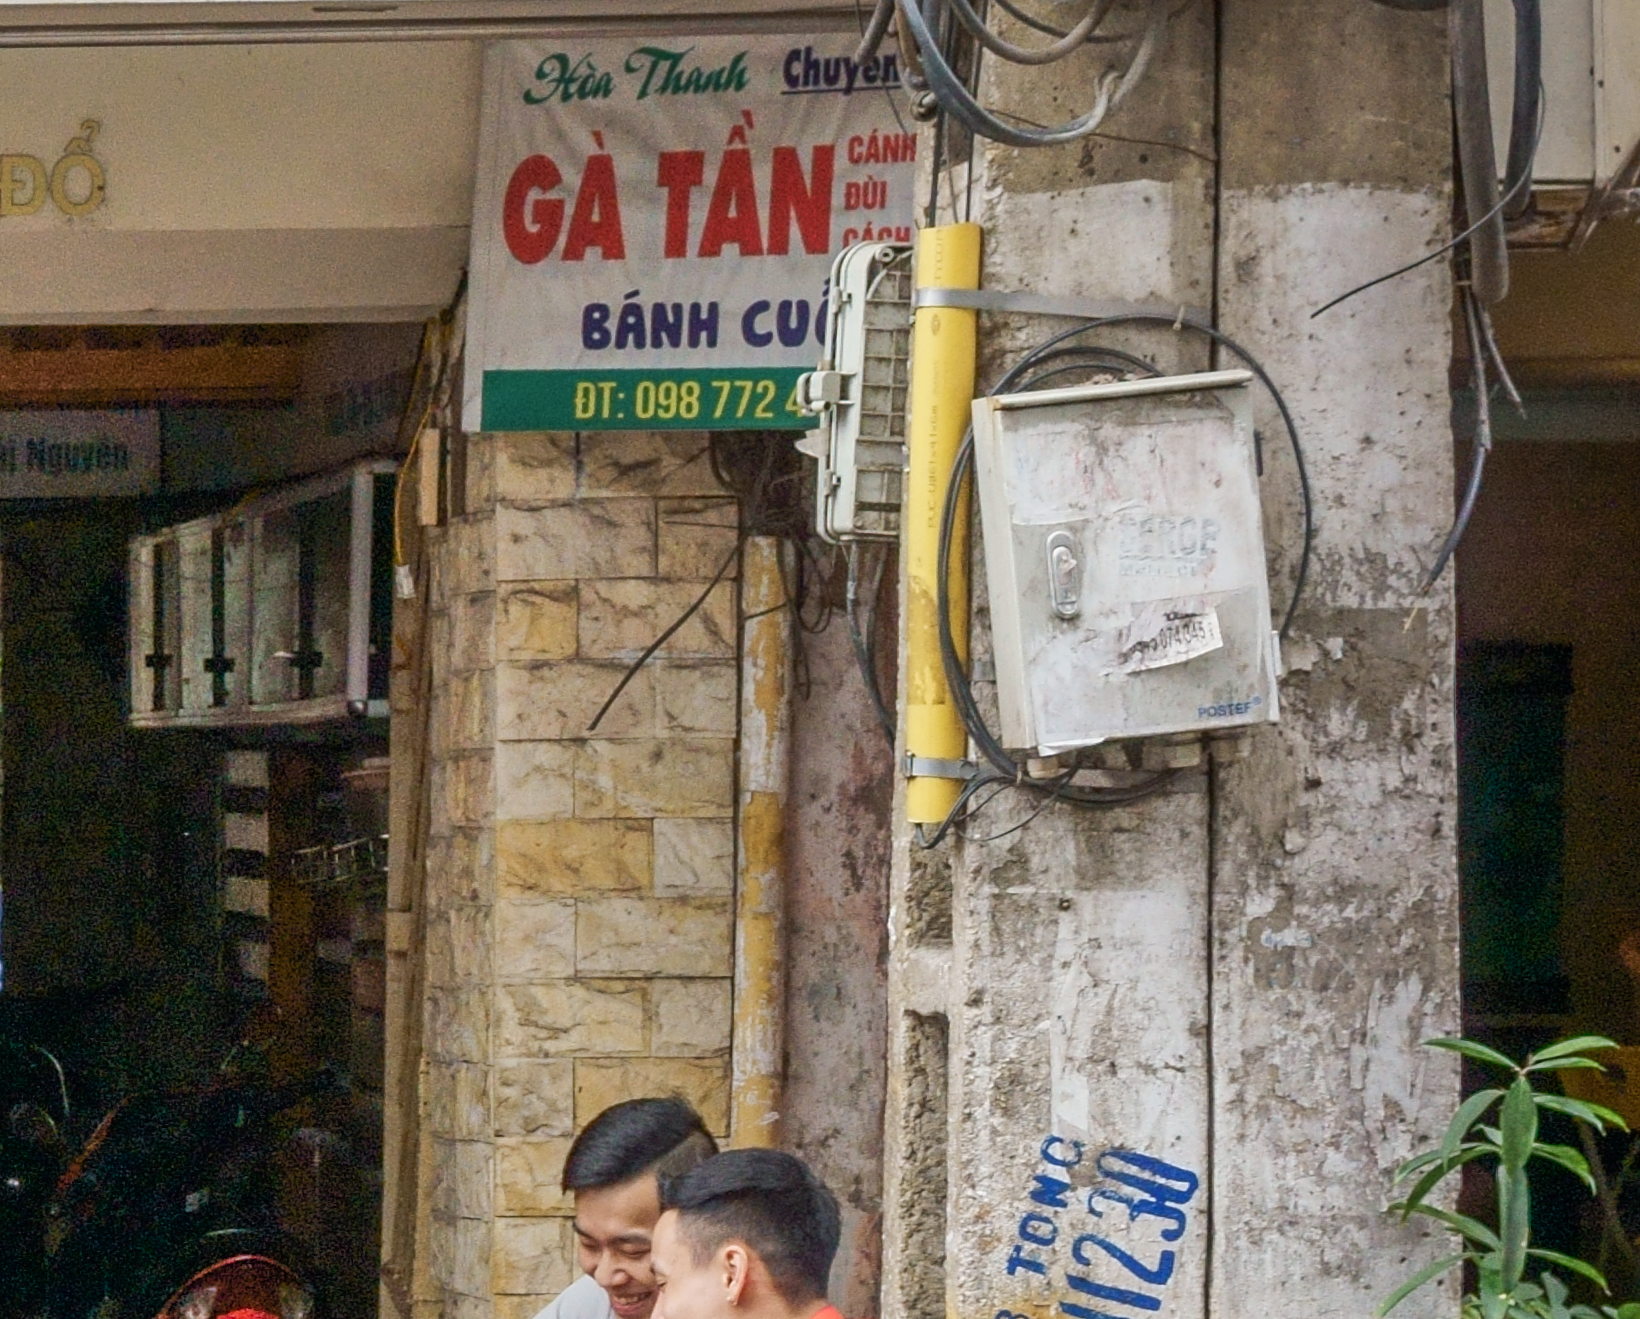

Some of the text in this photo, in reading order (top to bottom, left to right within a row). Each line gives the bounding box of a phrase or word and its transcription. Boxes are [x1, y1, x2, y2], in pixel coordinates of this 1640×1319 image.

[624, 46, 751, 99] Thanh
[848, 128, 917, 164] CÁNH
[503, 131, 626, 264] GÀ
[657, 110, 836, 259] TẦN
[844, 175, 887, 211] ĐÙI
[582, 289, 719, 350] BÁNH
[574, 381, 625, 419] ĐT:
[634, 381, 701, 420] 098
[711, 380, 776, 419] 772
